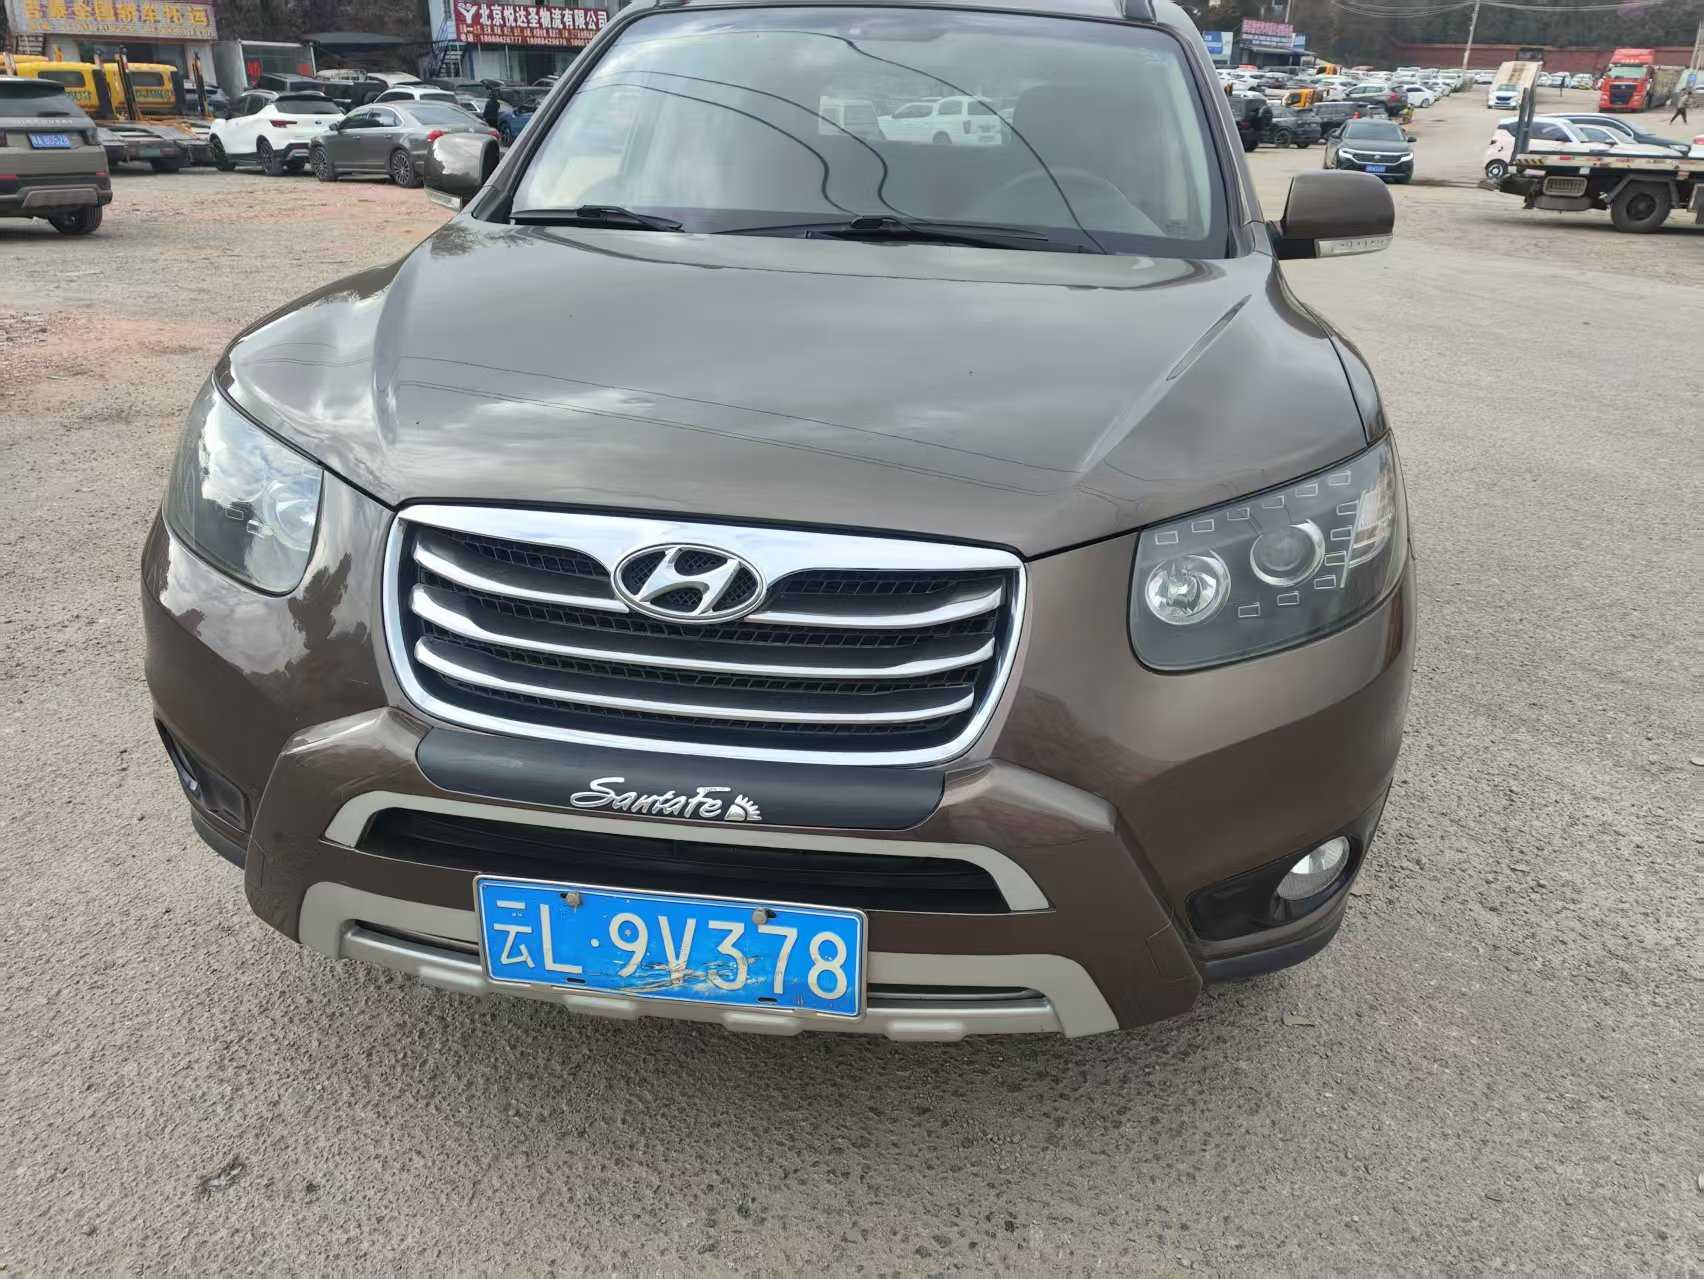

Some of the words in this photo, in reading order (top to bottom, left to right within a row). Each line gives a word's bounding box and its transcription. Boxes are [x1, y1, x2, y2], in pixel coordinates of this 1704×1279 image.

[479, 3, 608, 30] 北京悦达圣物流有限公司
